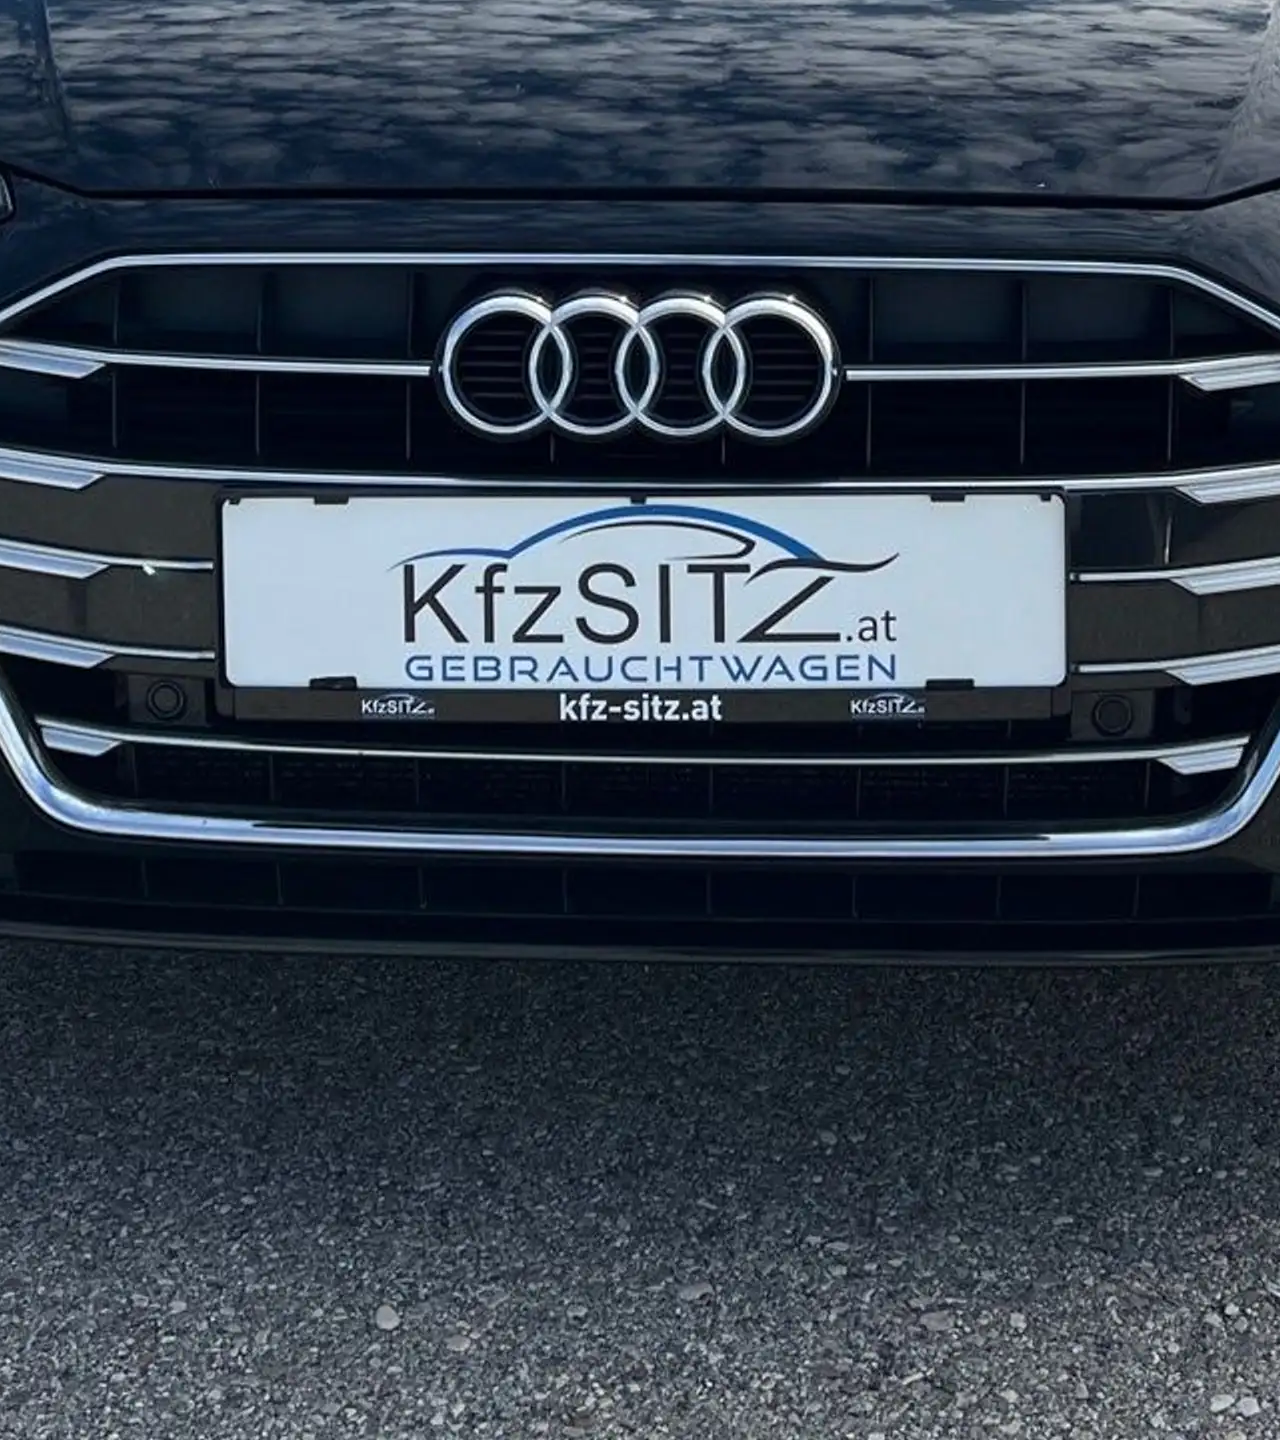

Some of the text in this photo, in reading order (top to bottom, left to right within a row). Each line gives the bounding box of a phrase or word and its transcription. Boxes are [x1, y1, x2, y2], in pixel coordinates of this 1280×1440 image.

[403, 554, 899, 645] KfzSITZ.at
[404, 654, 897, 682] GEBRAUCHTWAGEN
[559, 693, 722, 721] kfz-sitz.at
